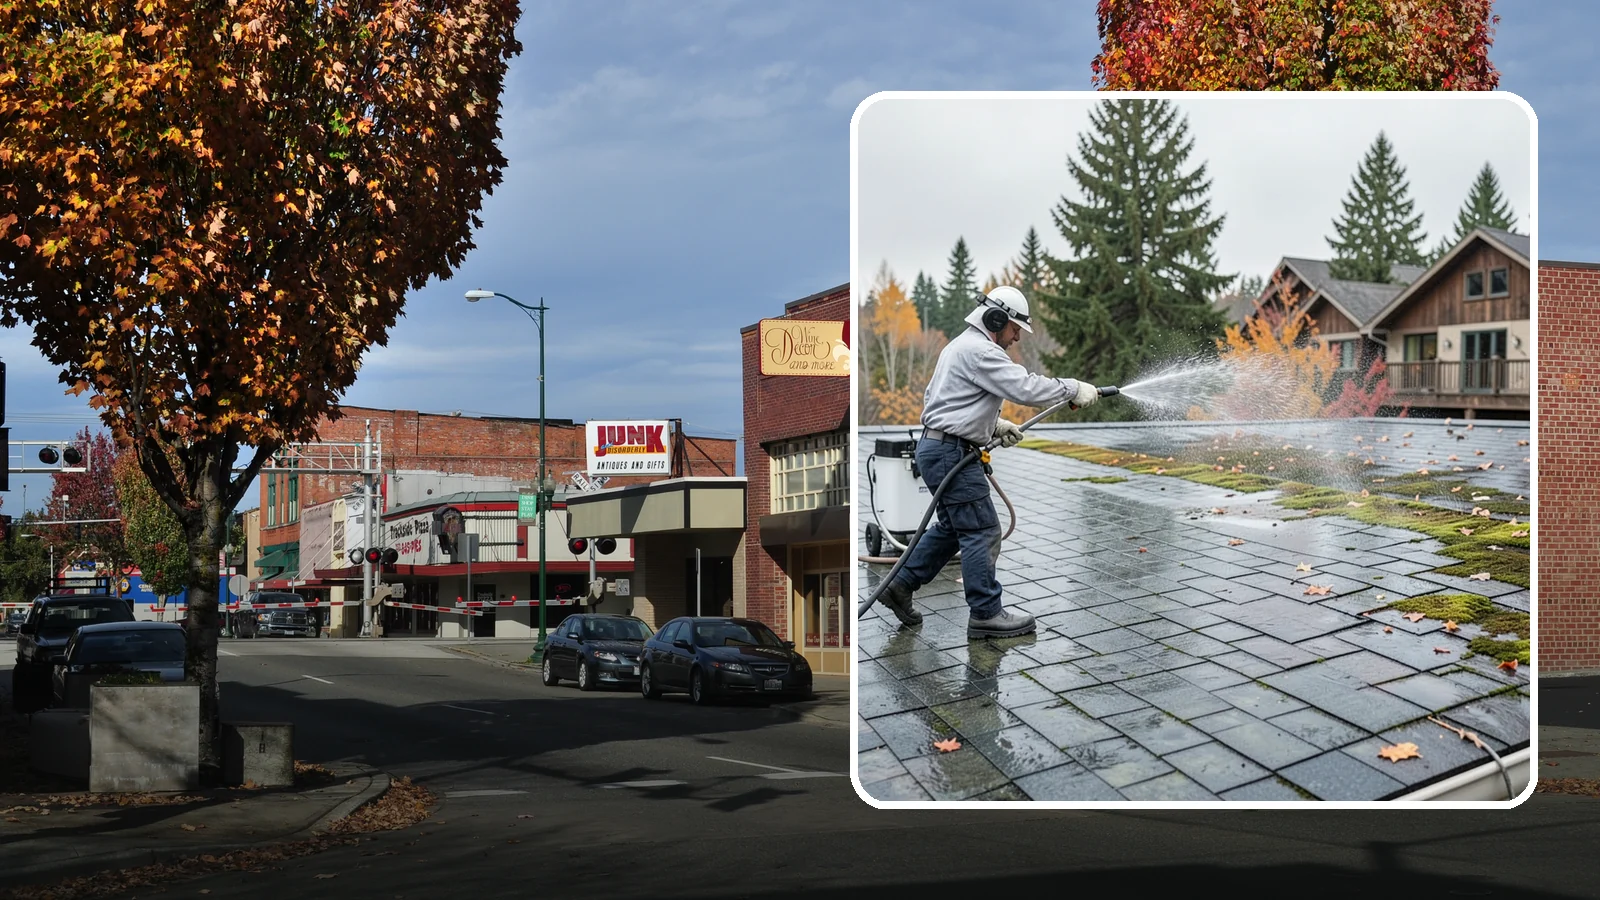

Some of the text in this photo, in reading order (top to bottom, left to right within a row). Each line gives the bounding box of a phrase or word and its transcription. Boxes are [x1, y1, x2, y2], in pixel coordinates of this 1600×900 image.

[595, 425, 665, 457] JUNK
[607, 446, 646, 454] DISORDERLY
[597, 460, 665, 470] ANTIQUES AND GIFTS
[414, 519, 429, 535] Pizza
